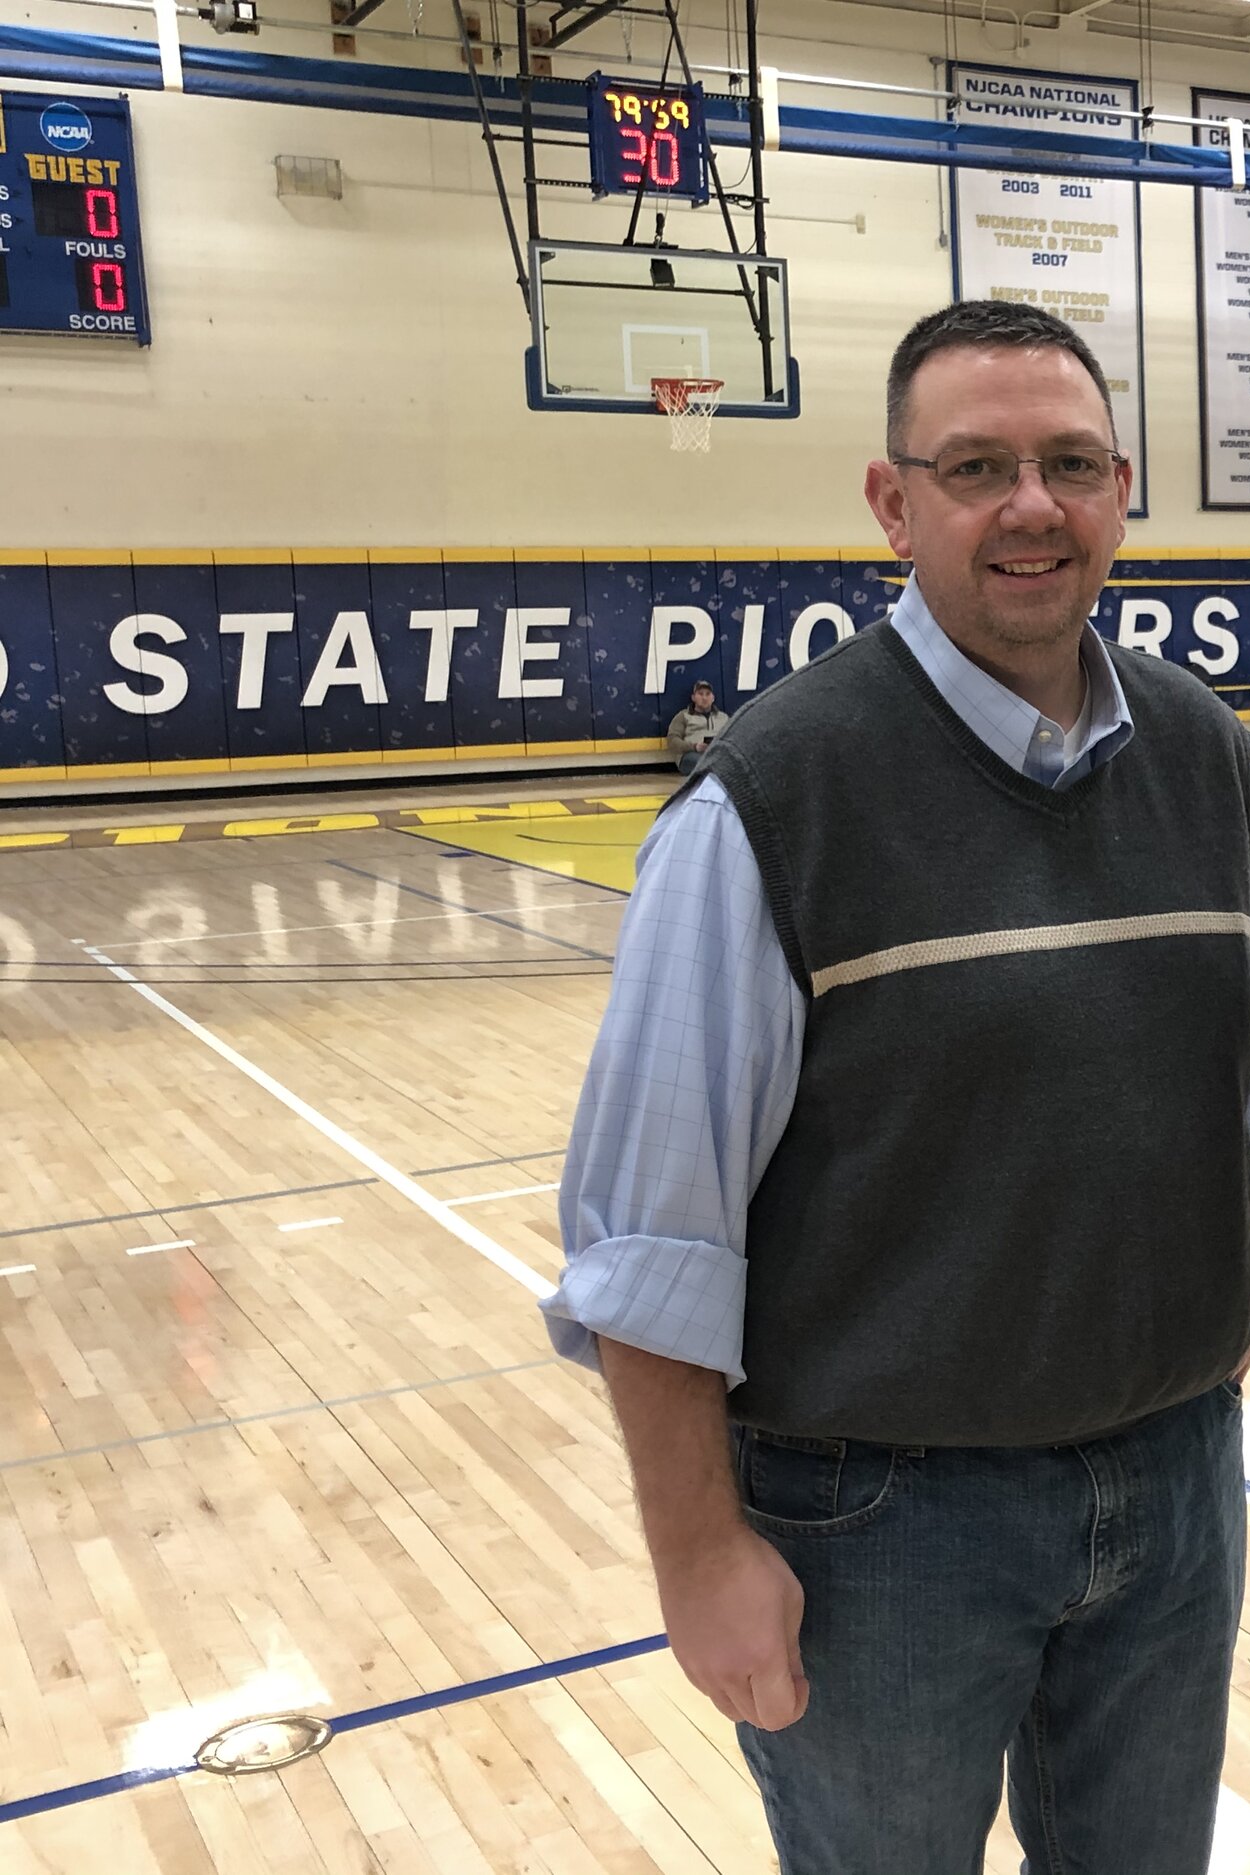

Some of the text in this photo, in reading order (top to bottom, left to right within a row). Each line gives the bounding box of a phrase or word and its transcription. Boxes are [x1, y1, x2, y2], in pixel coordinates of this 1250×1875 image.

[966, 79, 1121, 107] NJCAA NATIONAL
[48, 125, 89, 139] NCAA
[621, 129, 679, 186] 30
[24, 153, 120, 186] GUEST
[1002, 180, 1093, 199] 2003 2011
[85, 189, 120, 239] 0
[976, 214, 1119, 238] WOMEN'S OUTDOOR
[65, 242, 126, 259] FOULS
[994, 233, 1044, 249] TRACK
[1062, 238, 1103, 253] FIELD
[1032, 253, 1068, 267] 2007
[1225, 251, 1250, 261] MEN'S
[93, 263, 124, 311] 0
[990, 286, 1110, 306] MEN'S OUTDOOR
[69, 314, 136, 332] SCORE
[1063, 308, 1105, 323] FIELD
[102, 607, 571, 715] STATE
[644, 597, 1240, 695] PIORS
